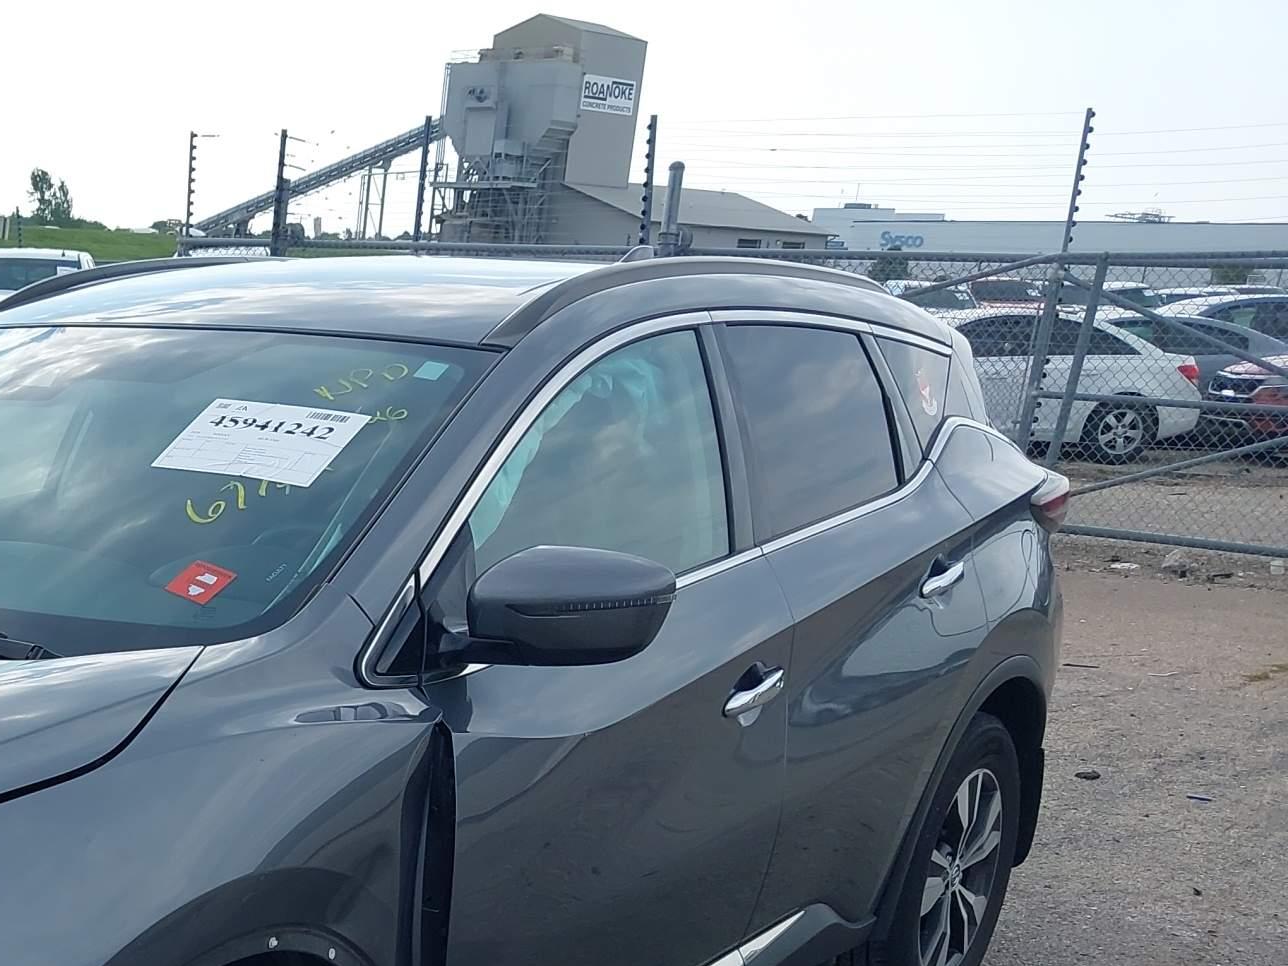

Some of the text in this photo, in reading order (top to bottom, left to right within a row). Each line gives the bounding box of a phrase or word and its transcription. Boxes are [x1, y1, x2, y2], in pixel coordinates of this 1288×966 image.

[584, 81, 634, 100] ROANOKE
[582, 101, 631, 113] CONCRETE PRODUCTS
[208, 415, 336, 441] 45941242
